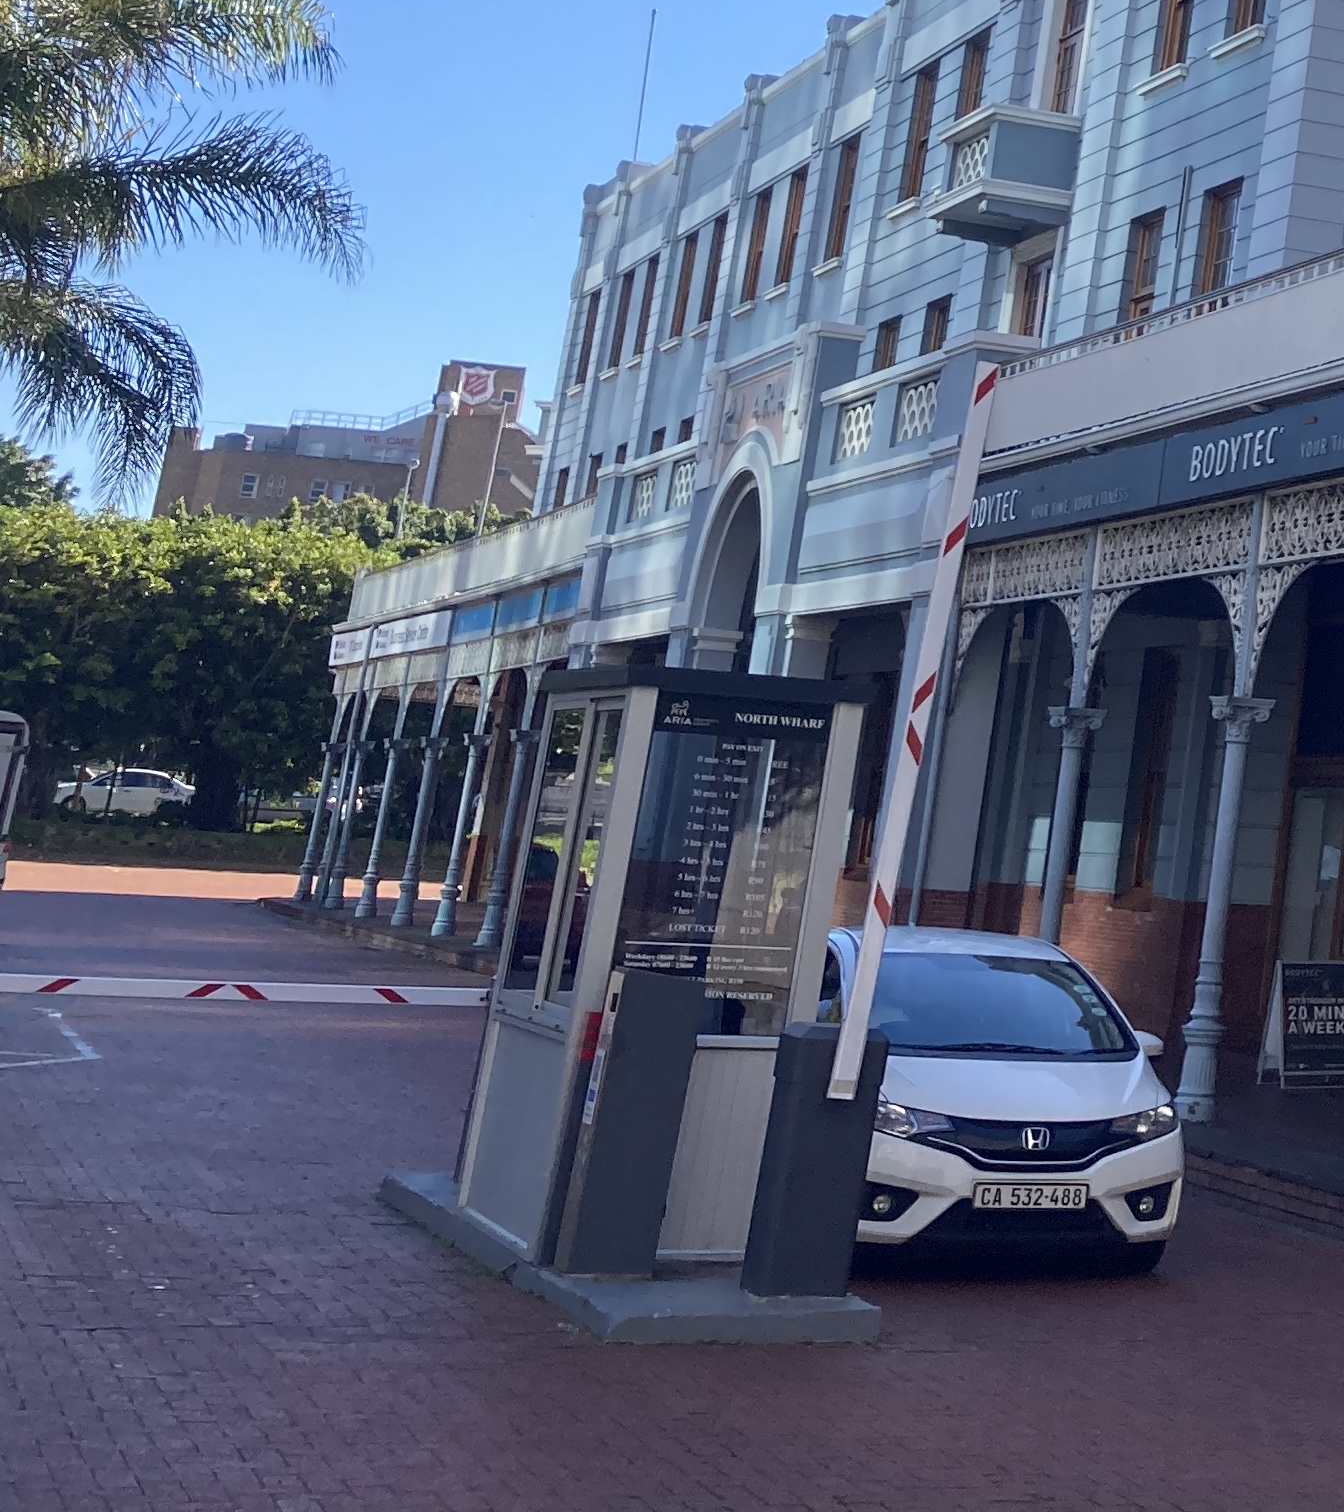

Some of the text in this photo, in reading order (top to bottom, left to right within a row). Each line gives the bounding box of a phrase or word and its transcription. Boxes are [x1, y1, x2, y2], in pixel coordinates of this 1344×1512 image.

[363, 434, 415, 447] WE CARE
[1188, 426, 1282, 482] BODYTEC
[1300, 441, 1327, 459] YOUR
[969, 489, 1020, 529] ODYTEC
[663, 716, 692, 726] ARIA
[735, 713, 826, 729] NORTH WHARF
[669, 923, 692, 932] LOST
[694, 924, 726, 934] TICKET
[1288, 1005, 1344, 1020] 20 MIN
[1288, 1021, 1298, 1034] A
[981, 1187, 1002, 1206] CA
